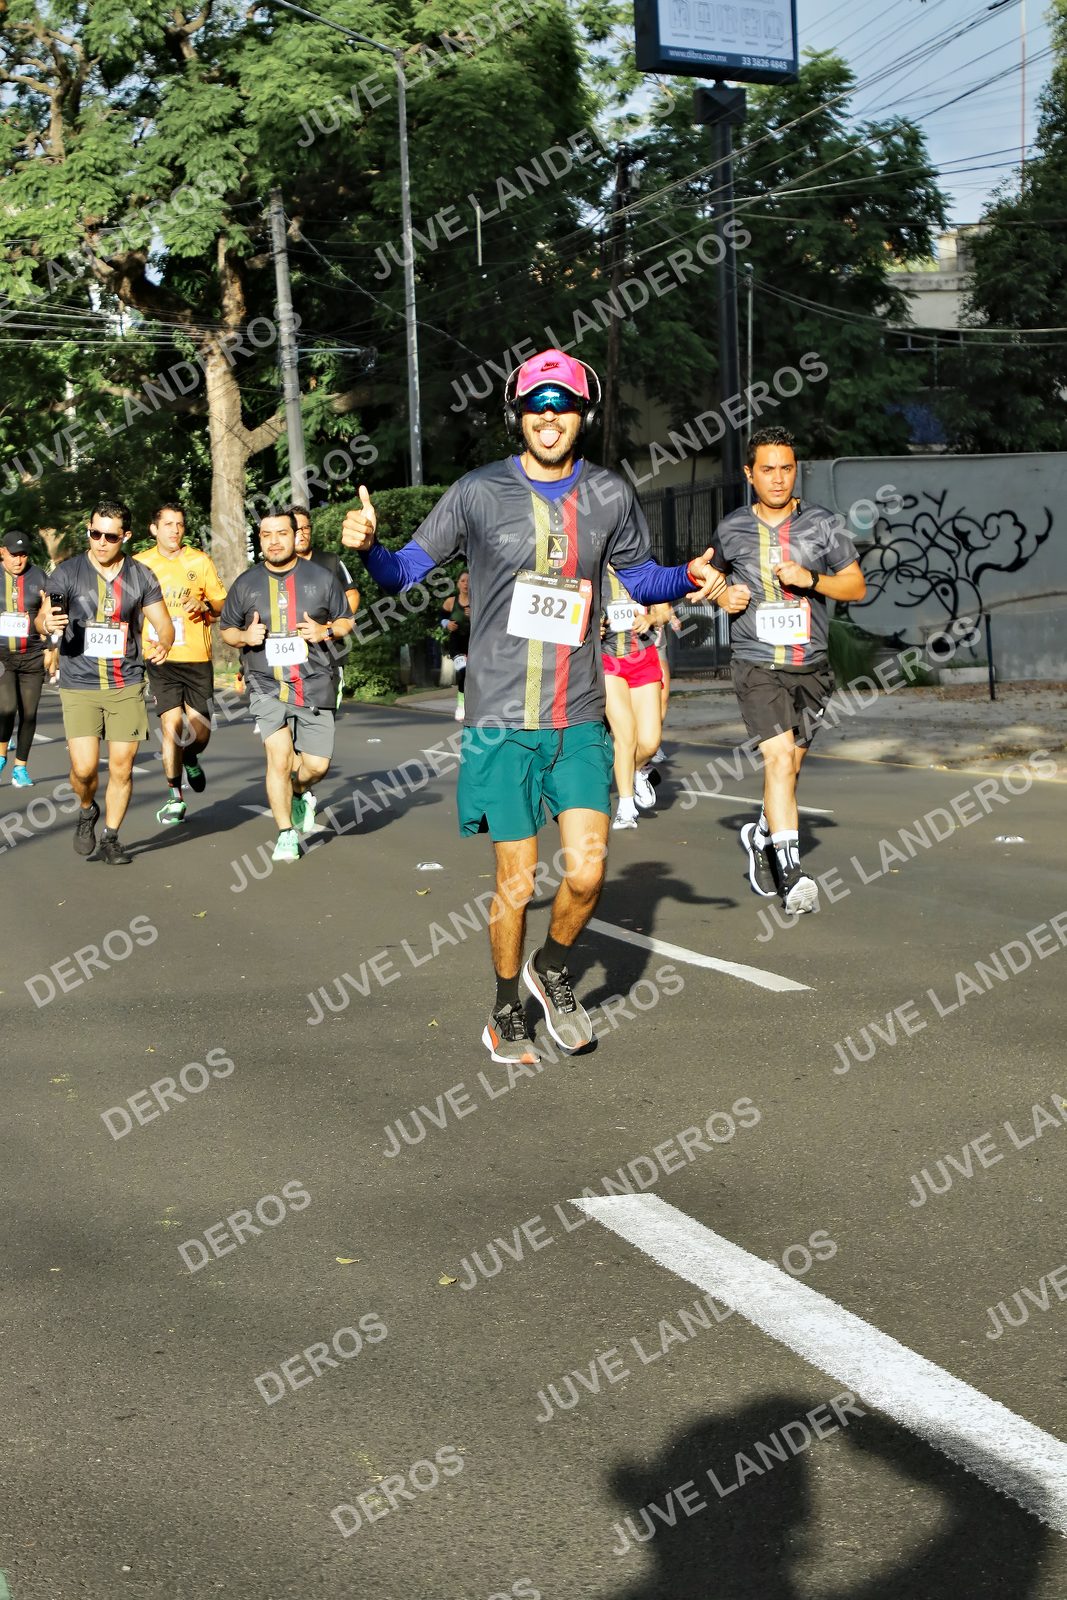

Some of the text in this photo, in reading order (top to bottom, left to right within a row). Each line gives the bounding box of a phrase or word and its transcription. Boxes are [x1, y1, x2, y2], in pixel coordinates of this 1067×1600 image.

[528, 594, 568, 620] 382
[760, 614, 802, 630] 11951
[90, 633, 118, 645] 8241
[275, 642, 296, 655] 364
